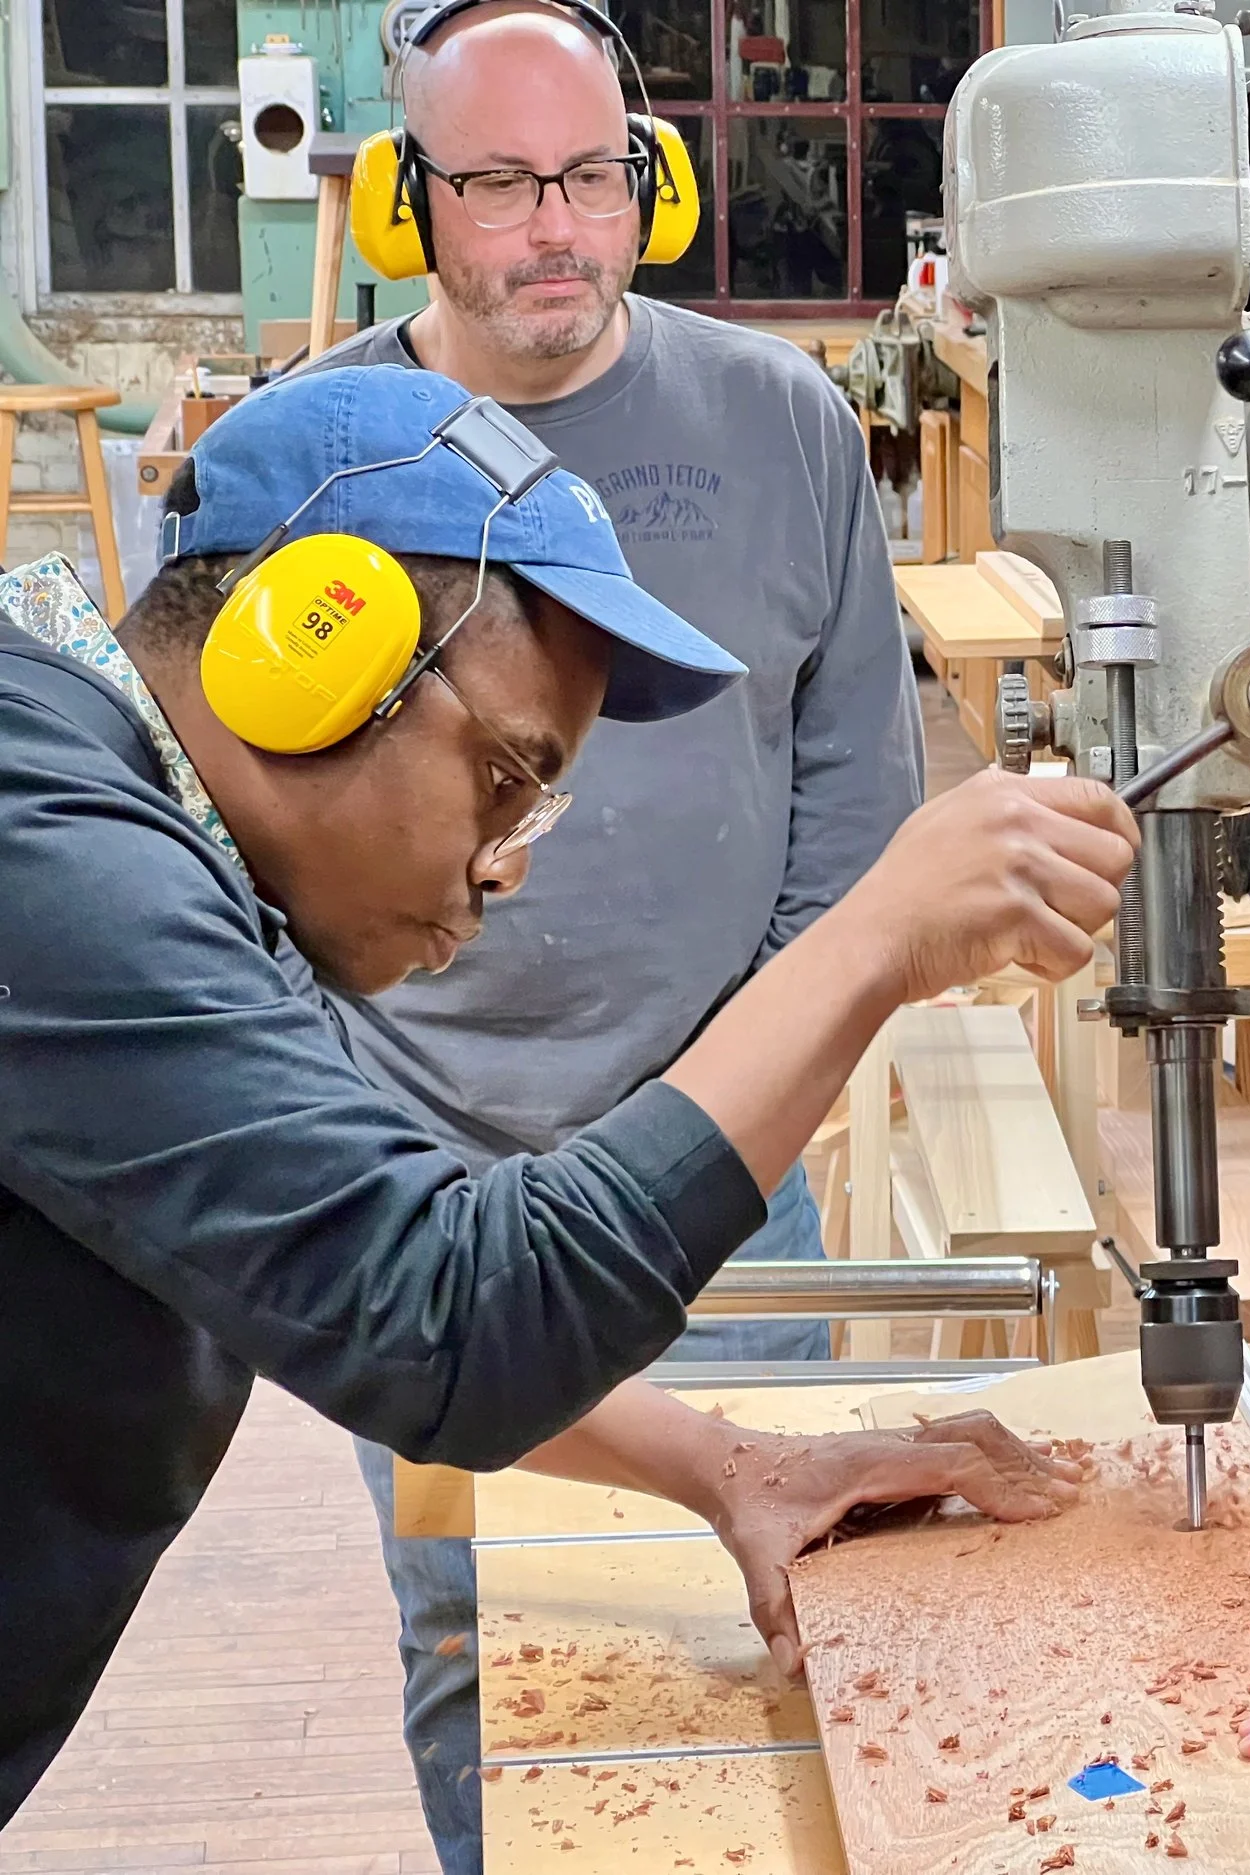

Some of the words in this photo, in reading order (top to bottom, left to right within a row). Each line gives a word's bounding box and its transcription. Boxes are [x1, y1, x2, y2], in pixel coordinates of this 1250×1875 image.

[595, 464, 660, 499] GRAND
[665, 464, 721, 495] TETON
[617, 530, 677, 543] ATIONAL
[315, 598, 348, 625] OPTIME
[324, 580, 366, 616] 3M
[302, 612, 333, 640] 98
